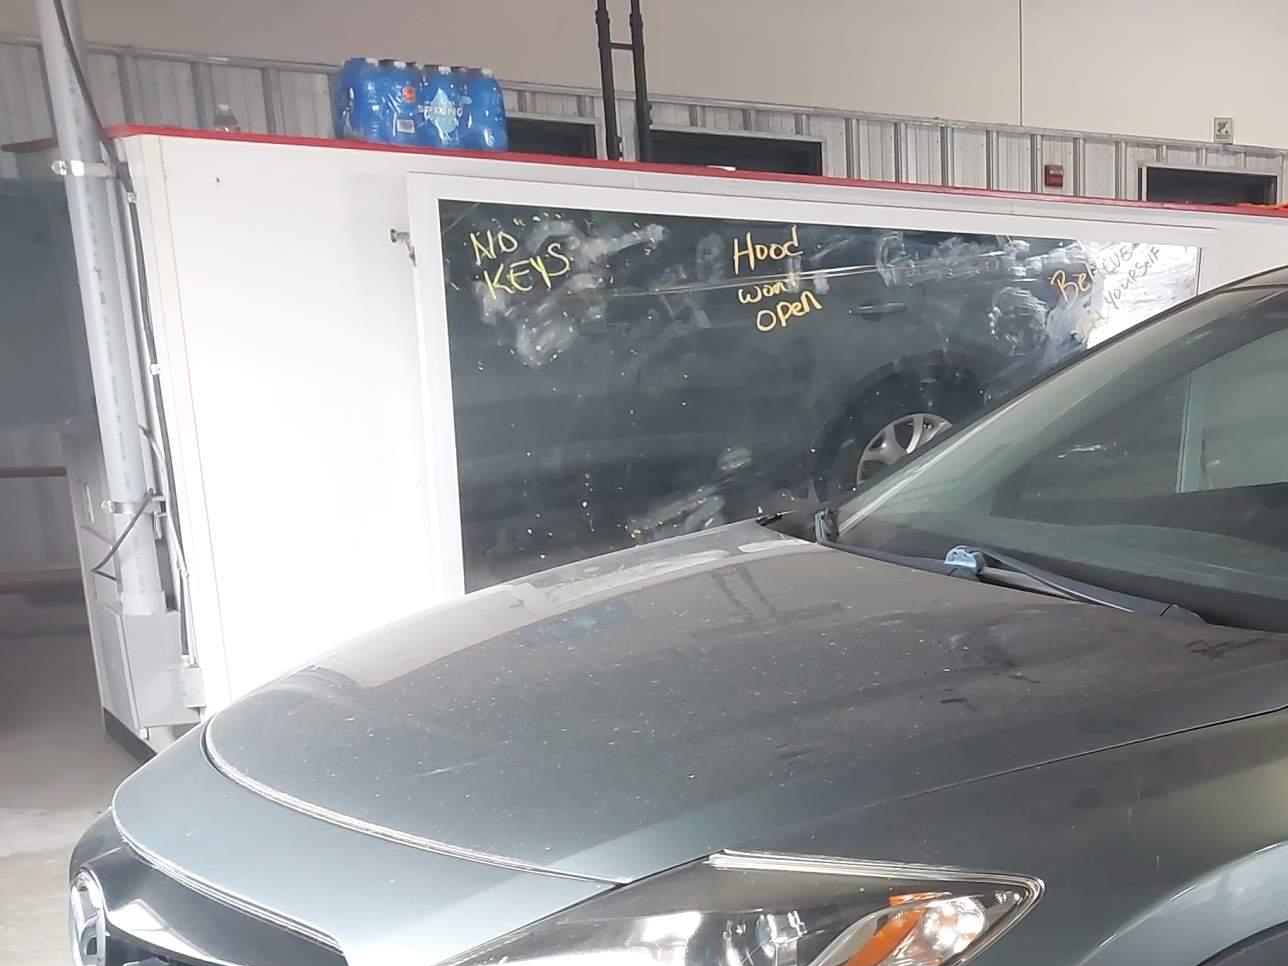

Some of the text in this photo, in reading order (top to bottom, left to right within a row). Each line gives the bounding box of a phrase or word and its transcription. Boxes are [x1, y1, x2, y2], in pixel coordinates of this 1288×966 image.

[470, 229, 519, 267] NO
[483, 242, 571, 301] KEYS
[733, 224, 804, 275] Hood
